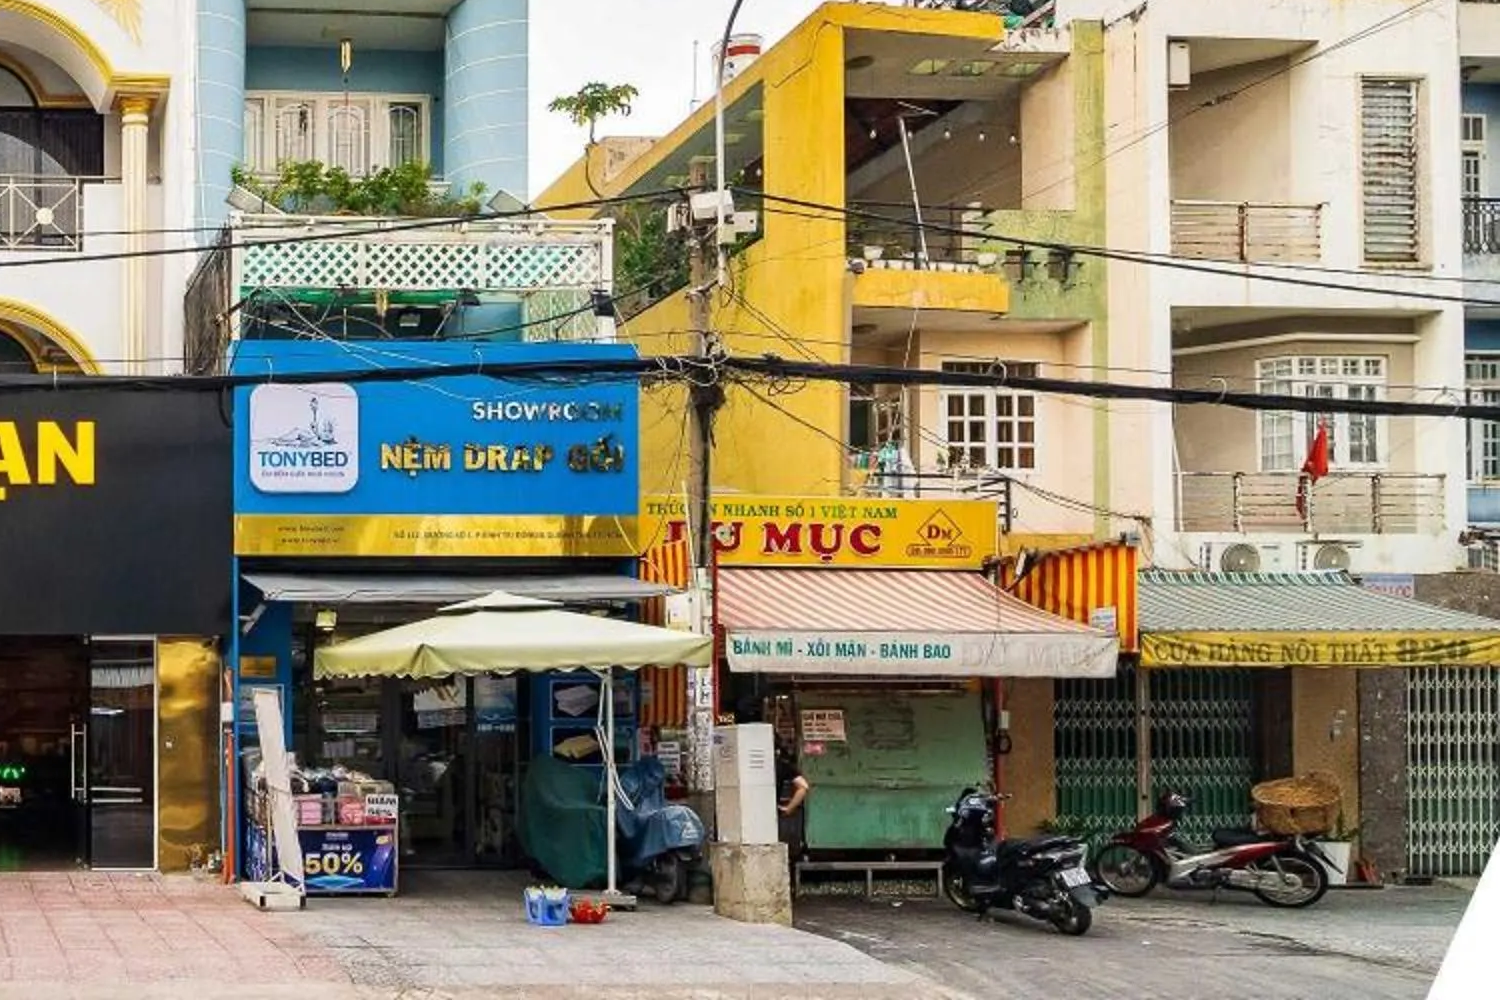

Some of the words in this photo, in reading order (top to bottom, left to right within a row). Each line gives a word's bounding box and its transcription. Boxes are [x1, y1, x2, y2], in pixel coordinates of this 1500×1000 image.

[258, 451, 349, 468] TONYBED
[380, 435, 451, 478] NỆM
[463, 443, 553, 472] DRAP
[723, 503, 779, 517] NHANH
[785, 501, 805, 517] SỐ
[821, 502, 857, 520] VIỆT
[863, 506, 898, 519] NAM
[762, 522, 882, 561] MỤC
[732, 637, 771, 656] BÁNH
[807, 638, 831, 657] XÔI
[879, 641, 918, 659] BÁNH
[923, 643, 951, 660] BAO
[1209, 638, 1272, 662] HÀNG
[305, 851, 364, 875] 50%
